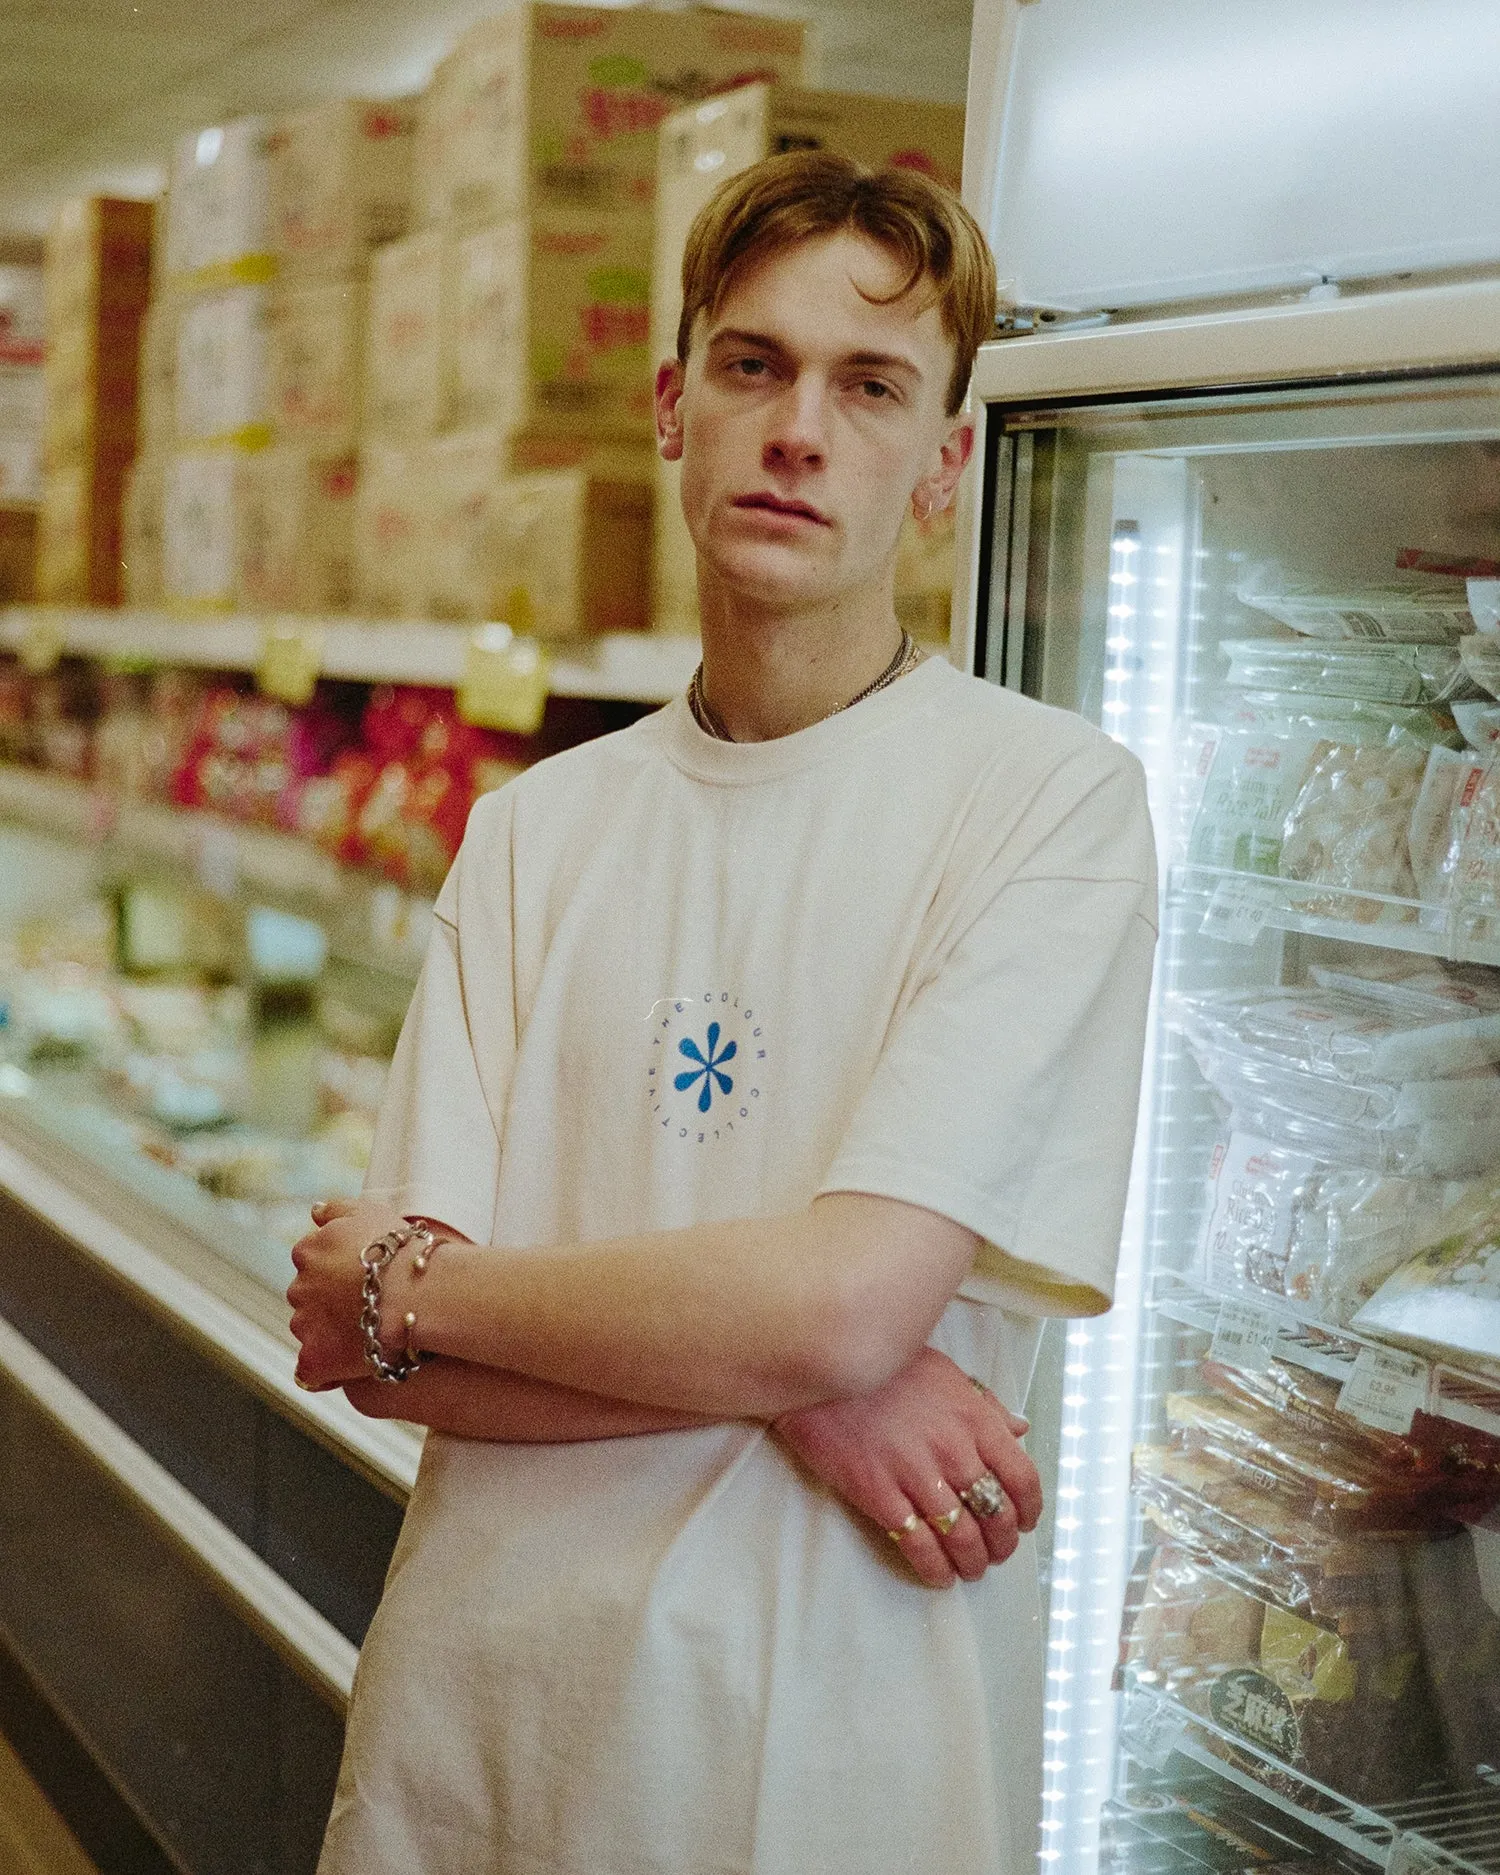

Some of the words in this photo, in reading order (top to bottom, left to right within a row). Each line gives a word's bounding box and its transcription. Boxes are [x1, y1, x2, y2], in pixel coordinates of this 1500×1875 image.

[653, 1002, 684, 1046] THE
[704, 992, 766, 1059] COLOUR
[648, 1067, 760, 1144] COLLECTIVE
